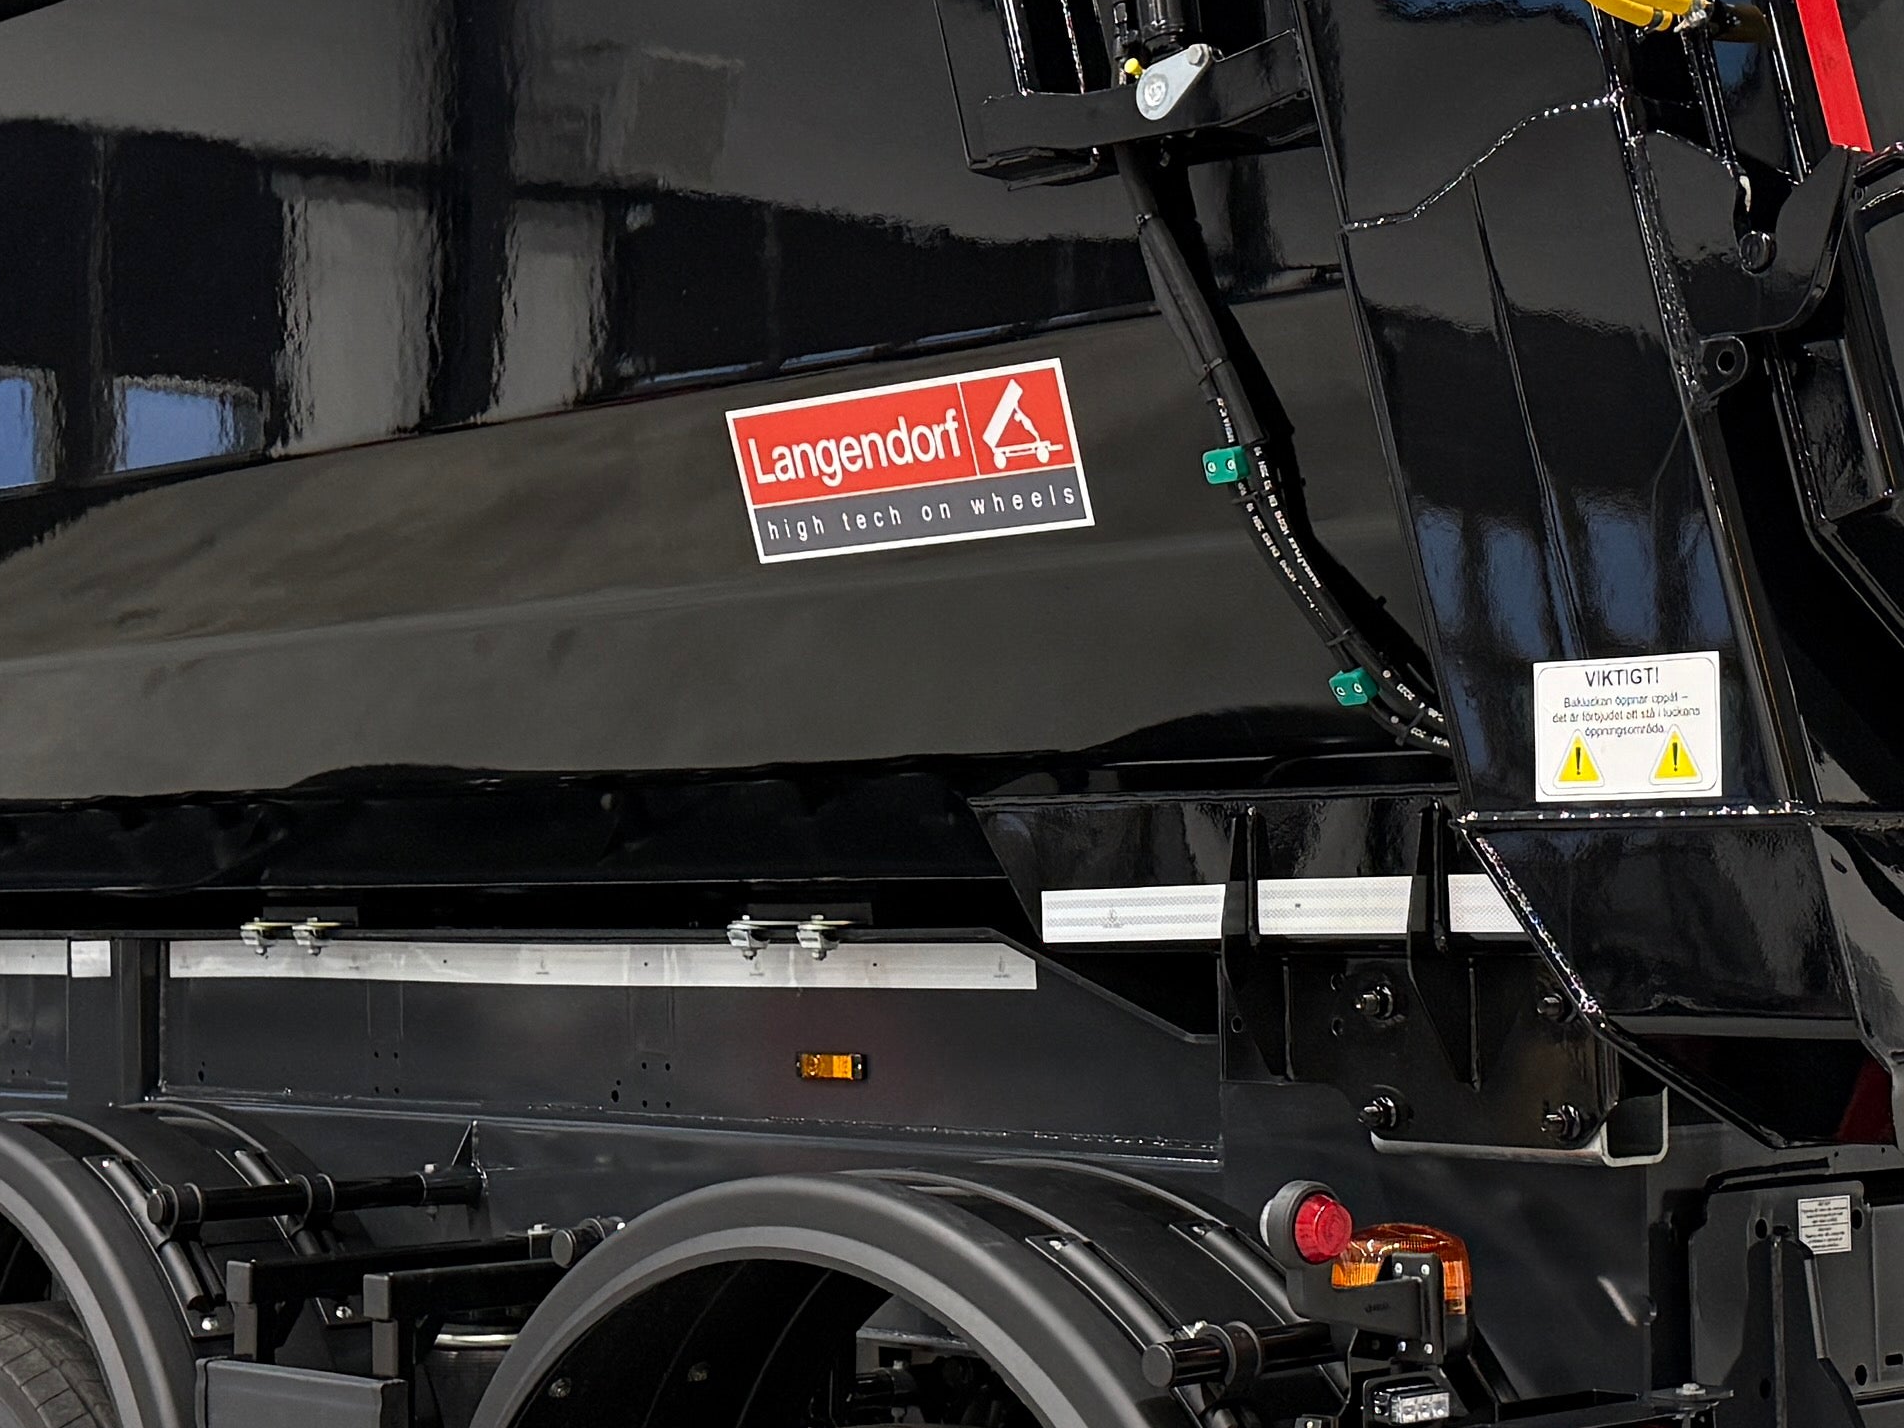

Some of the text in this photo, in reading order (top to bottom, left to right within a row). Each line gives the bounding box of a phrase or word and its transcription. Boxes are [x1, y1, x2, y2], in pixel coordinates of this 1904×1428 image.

[747, 408, 961, 488] Langendorf
[767, 484, 1076, 542] high tech on wheels
[1585, 667, 1660, 688] VIKTIGT!
